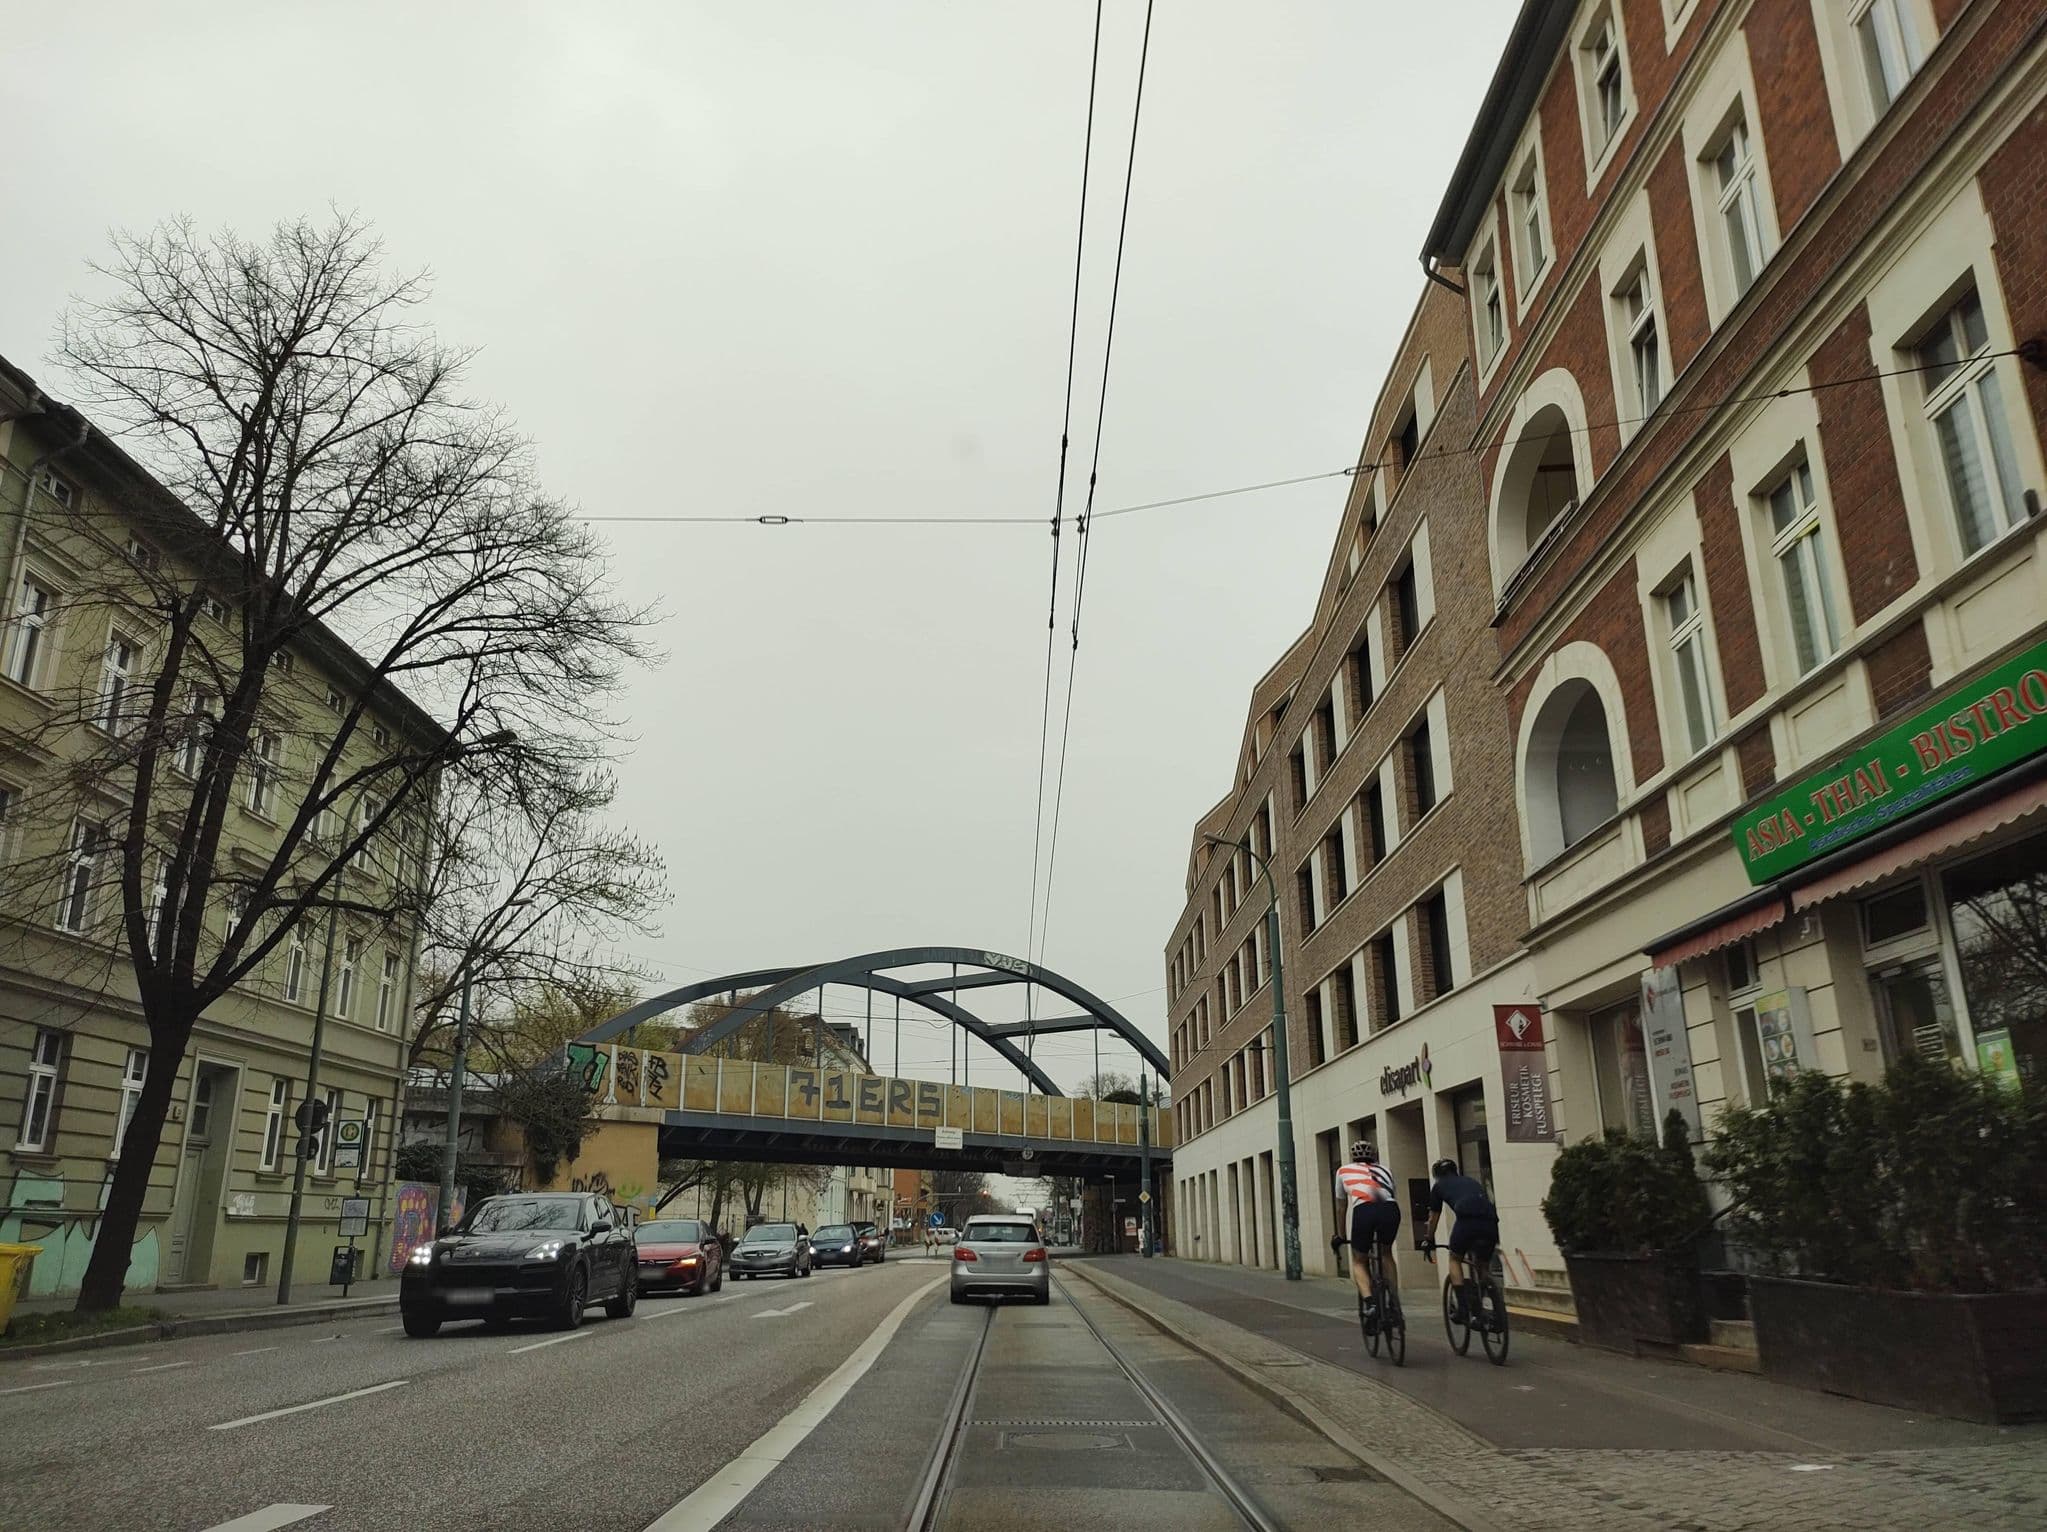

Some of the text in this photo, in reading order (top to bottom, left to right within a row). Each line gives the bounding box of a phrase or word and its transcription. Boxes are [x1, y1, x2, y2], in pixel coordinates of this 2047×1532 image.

[1746, 808, 1806, 862] ASIA
[1809, 757, 1893, 825] THAI
[1909, 669, 2047, 775] BISTRO
[1510, 1082, 1520, 1125] FRISEUR
[1520, 1065, 1533, 1118] KOSMETIK
[1532, 1073, 1547, 1135] FUSSPFLEGE
